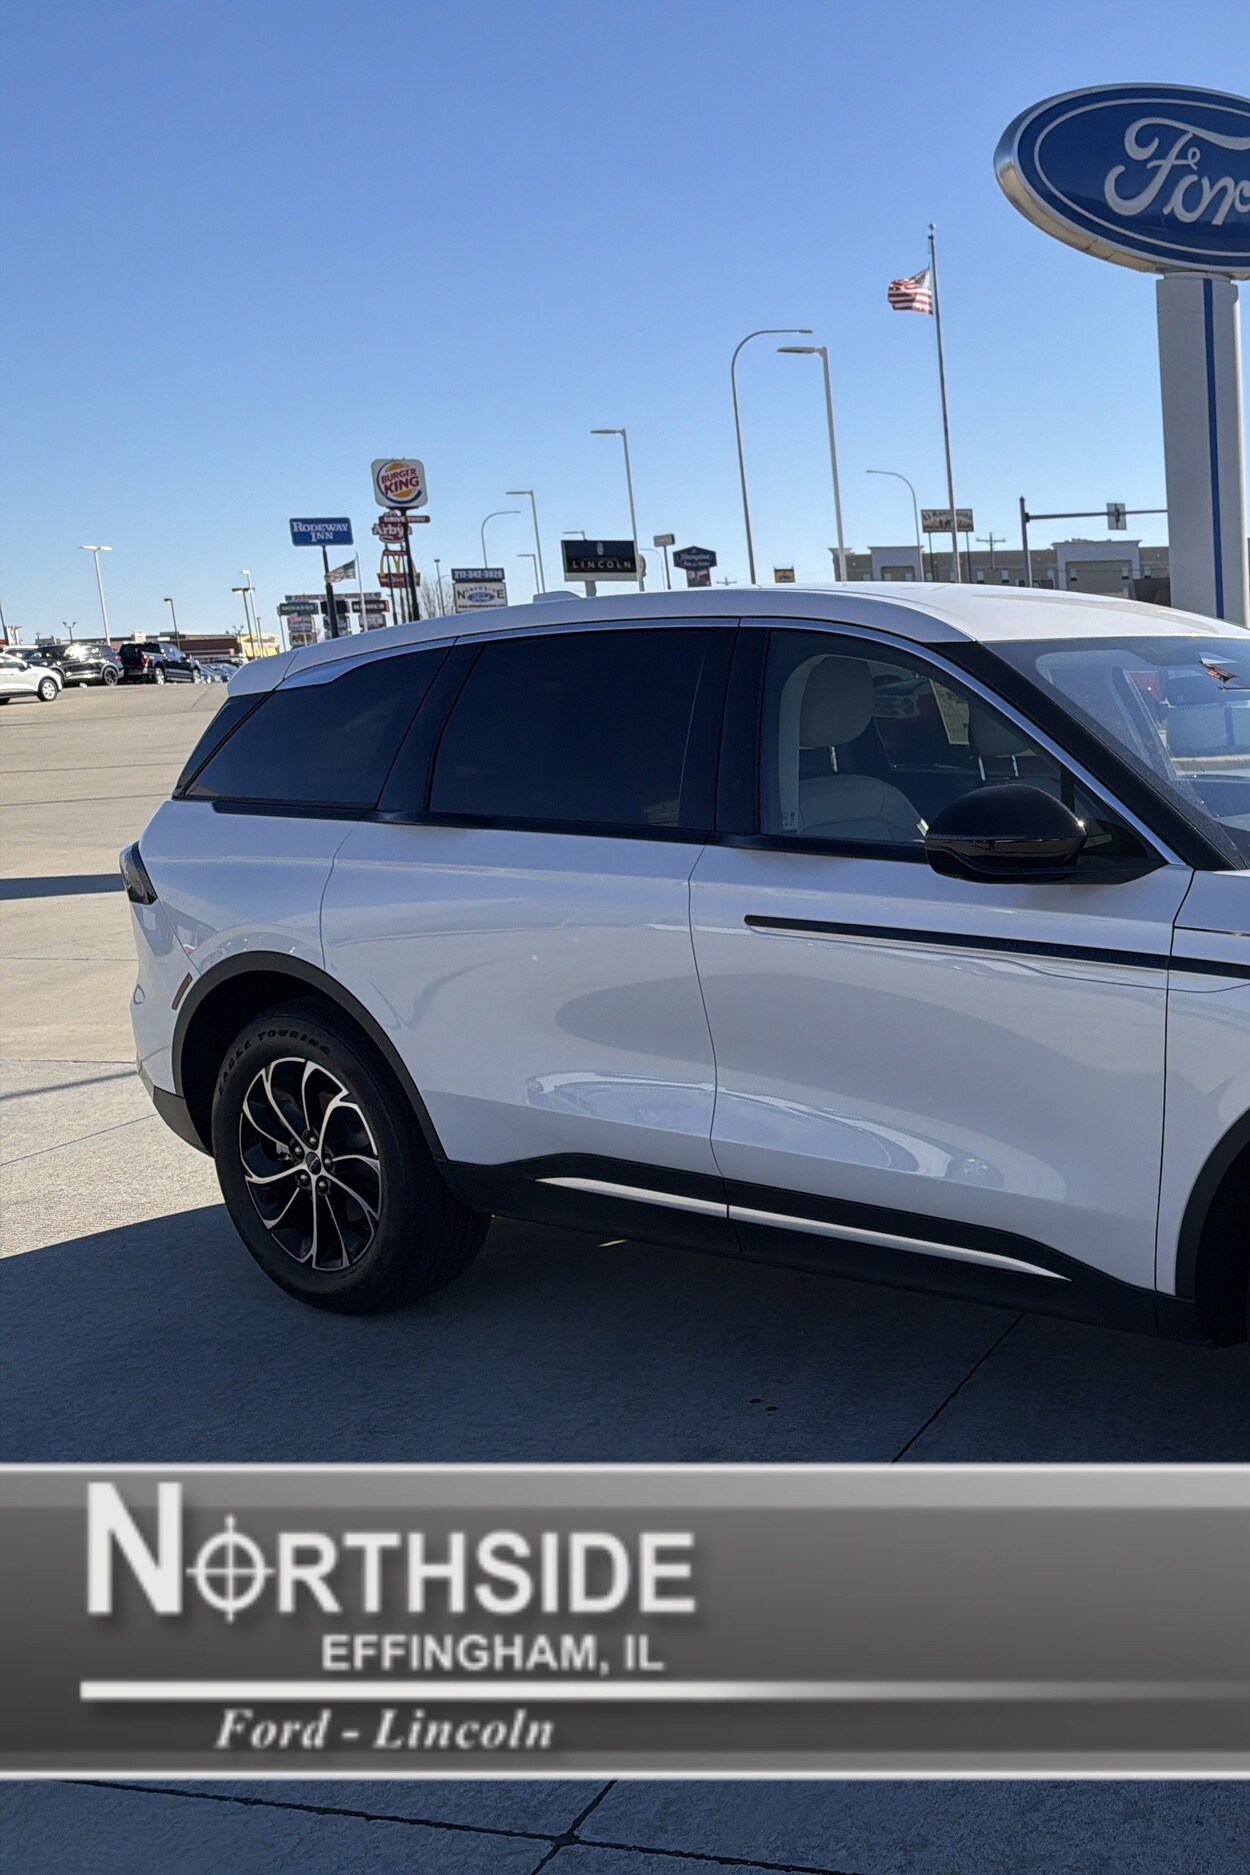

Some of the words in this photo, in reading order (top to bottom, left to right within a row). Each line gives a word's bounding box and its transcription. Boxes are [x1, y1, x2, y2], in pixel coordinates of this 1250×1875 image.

[381, 468, 417, 485] BURGER
[384, 476, 420, 495] KING
[292, 522, 348, 532] RODEWAY
[311, 532, 333, 542] INN
[572, 560, 632, 569] LINCOLN
[257, 1029, 331, 1056] TOURING
